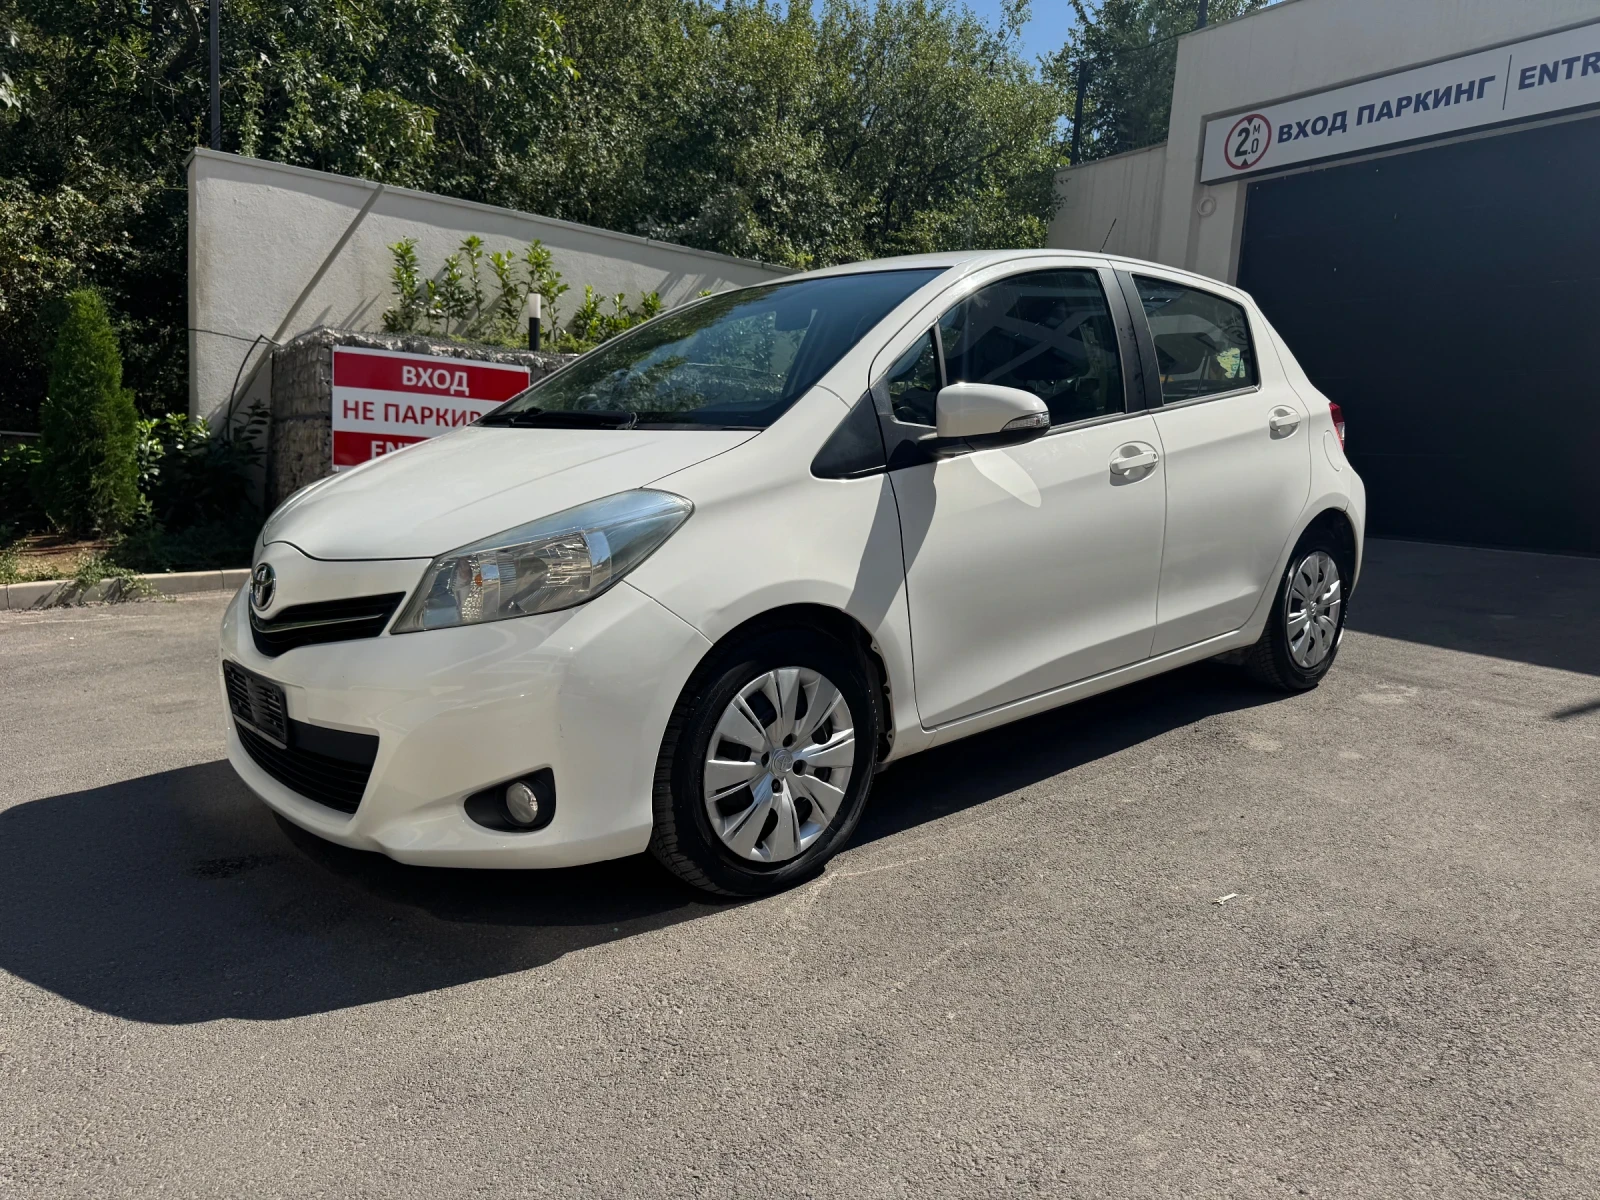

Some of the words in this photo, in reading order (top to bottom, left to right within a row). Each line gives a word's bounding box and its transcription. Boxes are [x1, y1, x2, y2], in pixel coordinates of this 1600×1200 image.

[1518, 51, 1600, 90] ENTR
[1277, 110, 1347, 144] ВХОД
[1356, 75, 1496, 127] ПАРКИНГ
[402, 365, 470, 396] ВХОД
[342, 399, 375, 421] НЕ
